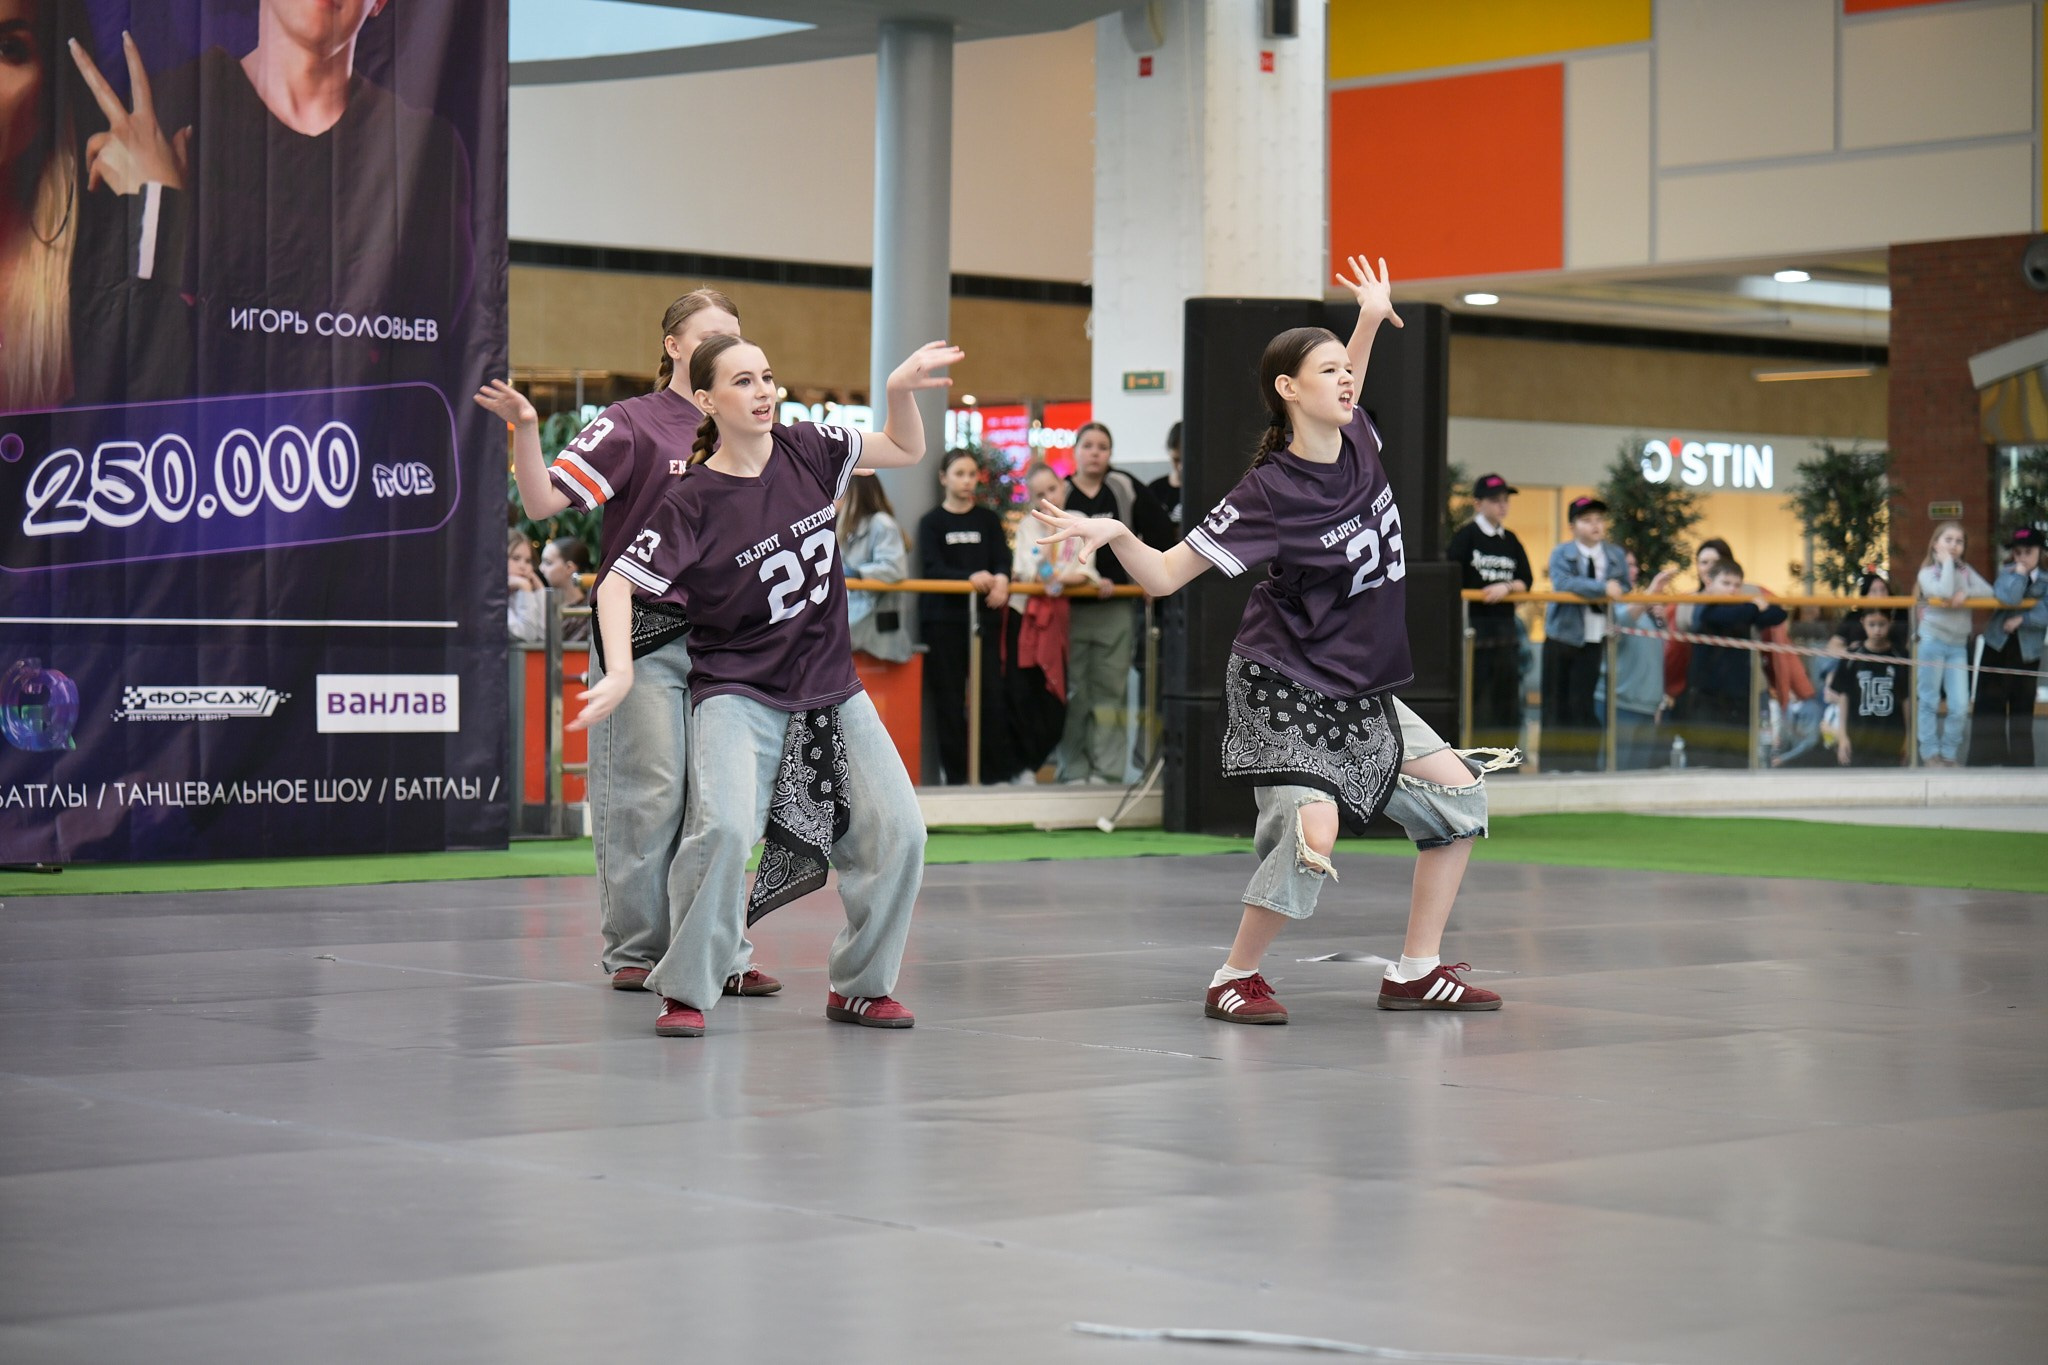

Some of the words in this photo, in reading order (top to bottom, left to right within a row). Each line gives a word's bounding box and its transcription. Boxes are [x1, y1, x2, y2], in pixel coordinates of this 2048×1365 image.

[231, 307, 308, 334] ИГОРЬ
[315, 312, 439, 342] СОЛОВЬЕВ
[22, 421, 360, 537] 250.000
[372, 462, 436, 498] RUB
[1641, 437, 1774, 489] O'STIN
[1319, 514, 1363, 549] ENJPOY
[735, 533, 781, 569] ENJPOY
[1345, 503, 1407, 599] 23
[758, 528, 836, 626] 23
[149, 691, 258, 705] ФОРСАЖ
[327, 692, 447, 715] ванлав
[1857, 670, 1894, 717] 15
[113, 779, 307, 808] ТАНЦЕВАЛЬНОЕ
[314, 778, 373, 803] ШОУ
[395, 776, 481, 801] БАТТЛЫ
